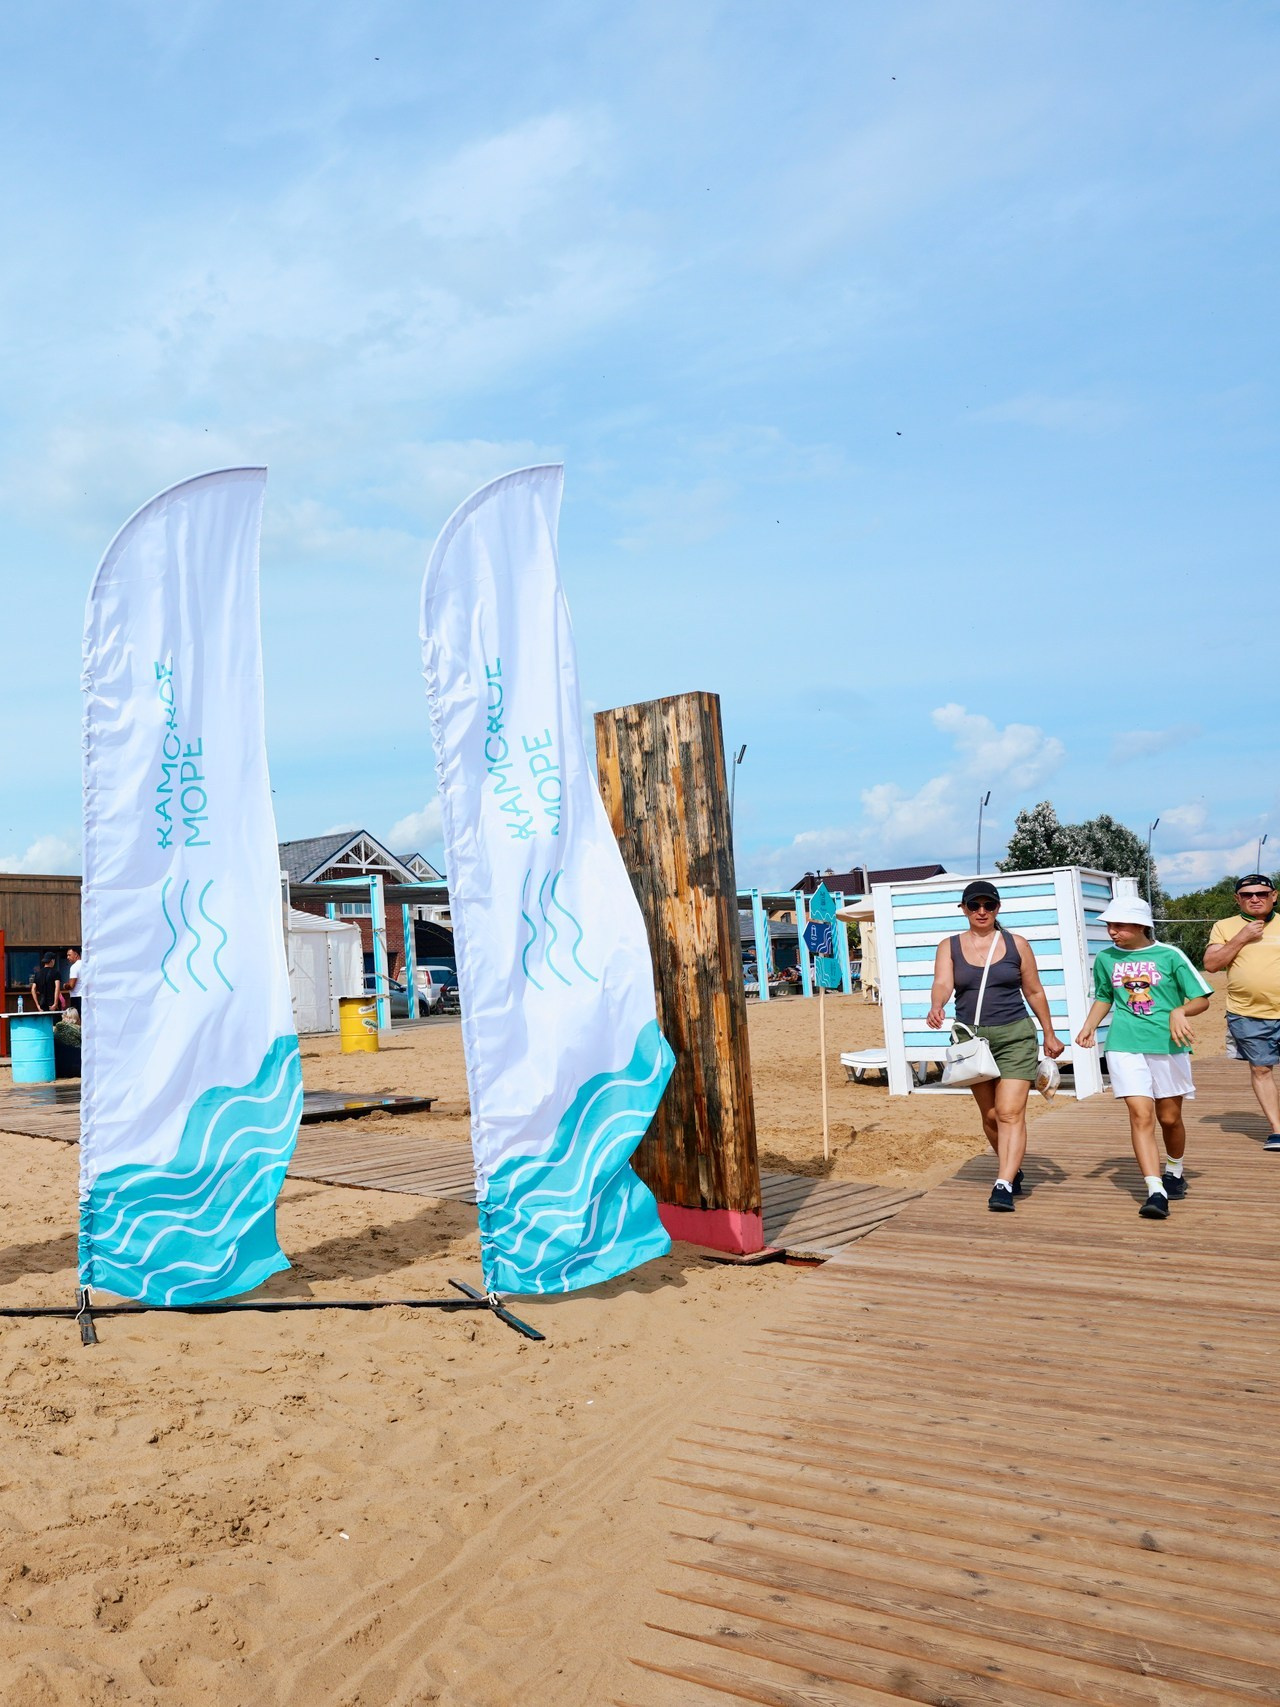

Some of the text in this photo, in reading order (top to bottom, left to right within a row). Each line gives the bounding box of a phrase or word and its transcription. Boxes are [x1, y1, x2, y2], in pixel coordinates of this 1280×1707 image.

[153, 656, 182, 851] КАМСКОЕ
[180, 737, 212, 848] МОРЕ
[1112, 970, 1162, 988] STP
[1113, 961, 1156, 974] NEVER
